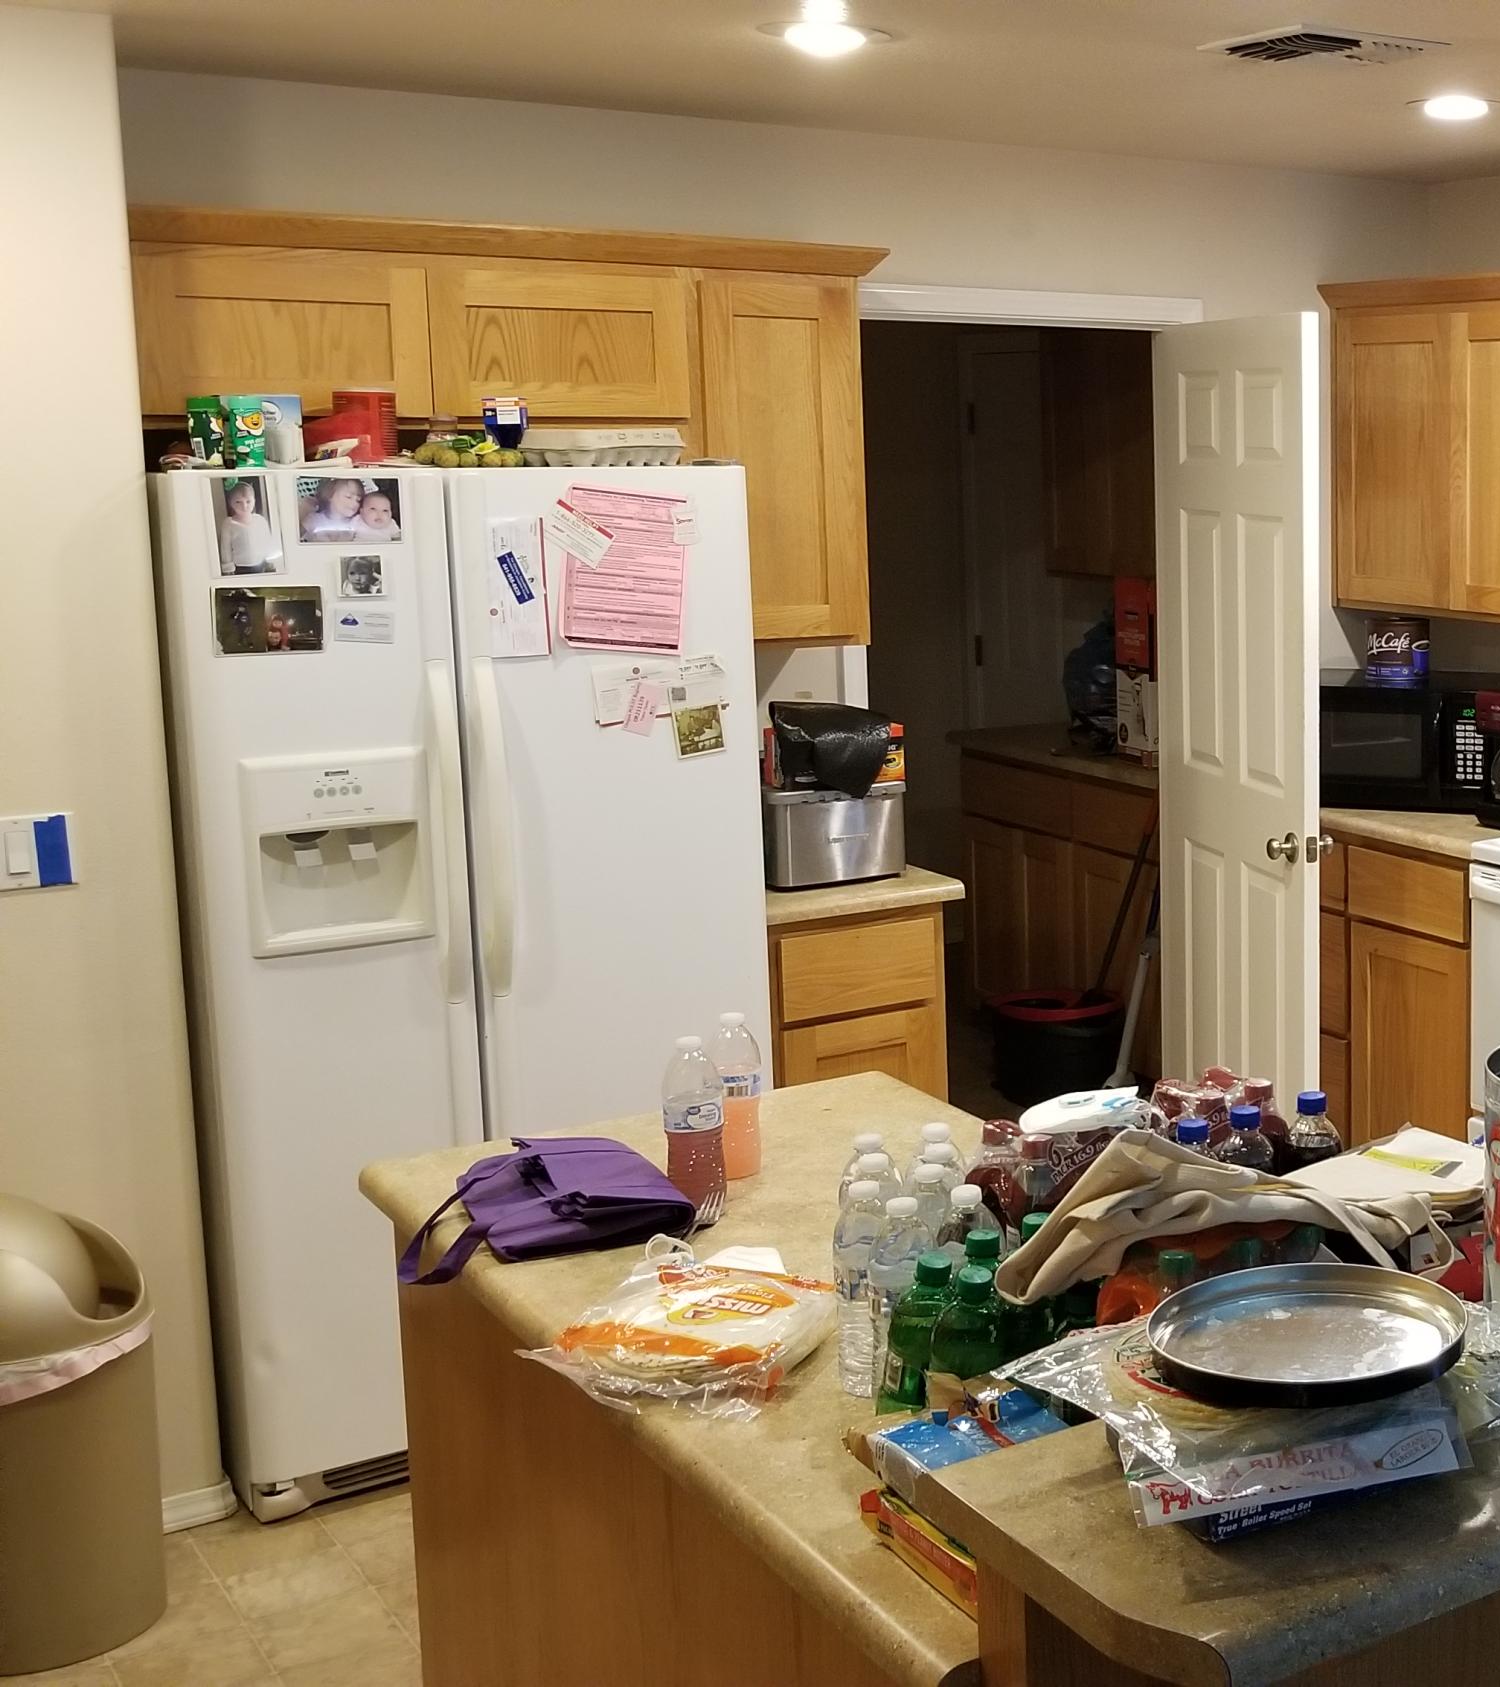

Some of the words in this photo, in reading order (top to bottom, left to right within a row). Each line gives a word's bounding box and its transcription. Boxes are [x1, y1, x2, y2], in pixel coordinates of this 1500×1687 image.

[1367, 632, 1411, 654] McCafé
[1051, 1158, 1074, 1185] PACK
[1217, 1523, 1238, 1536] True
[1241, 1513, 1267, 1527] Roller
[1268, 1506, 1296, 1520] Speed
[1297, 1500, 1313, 1511] Set
